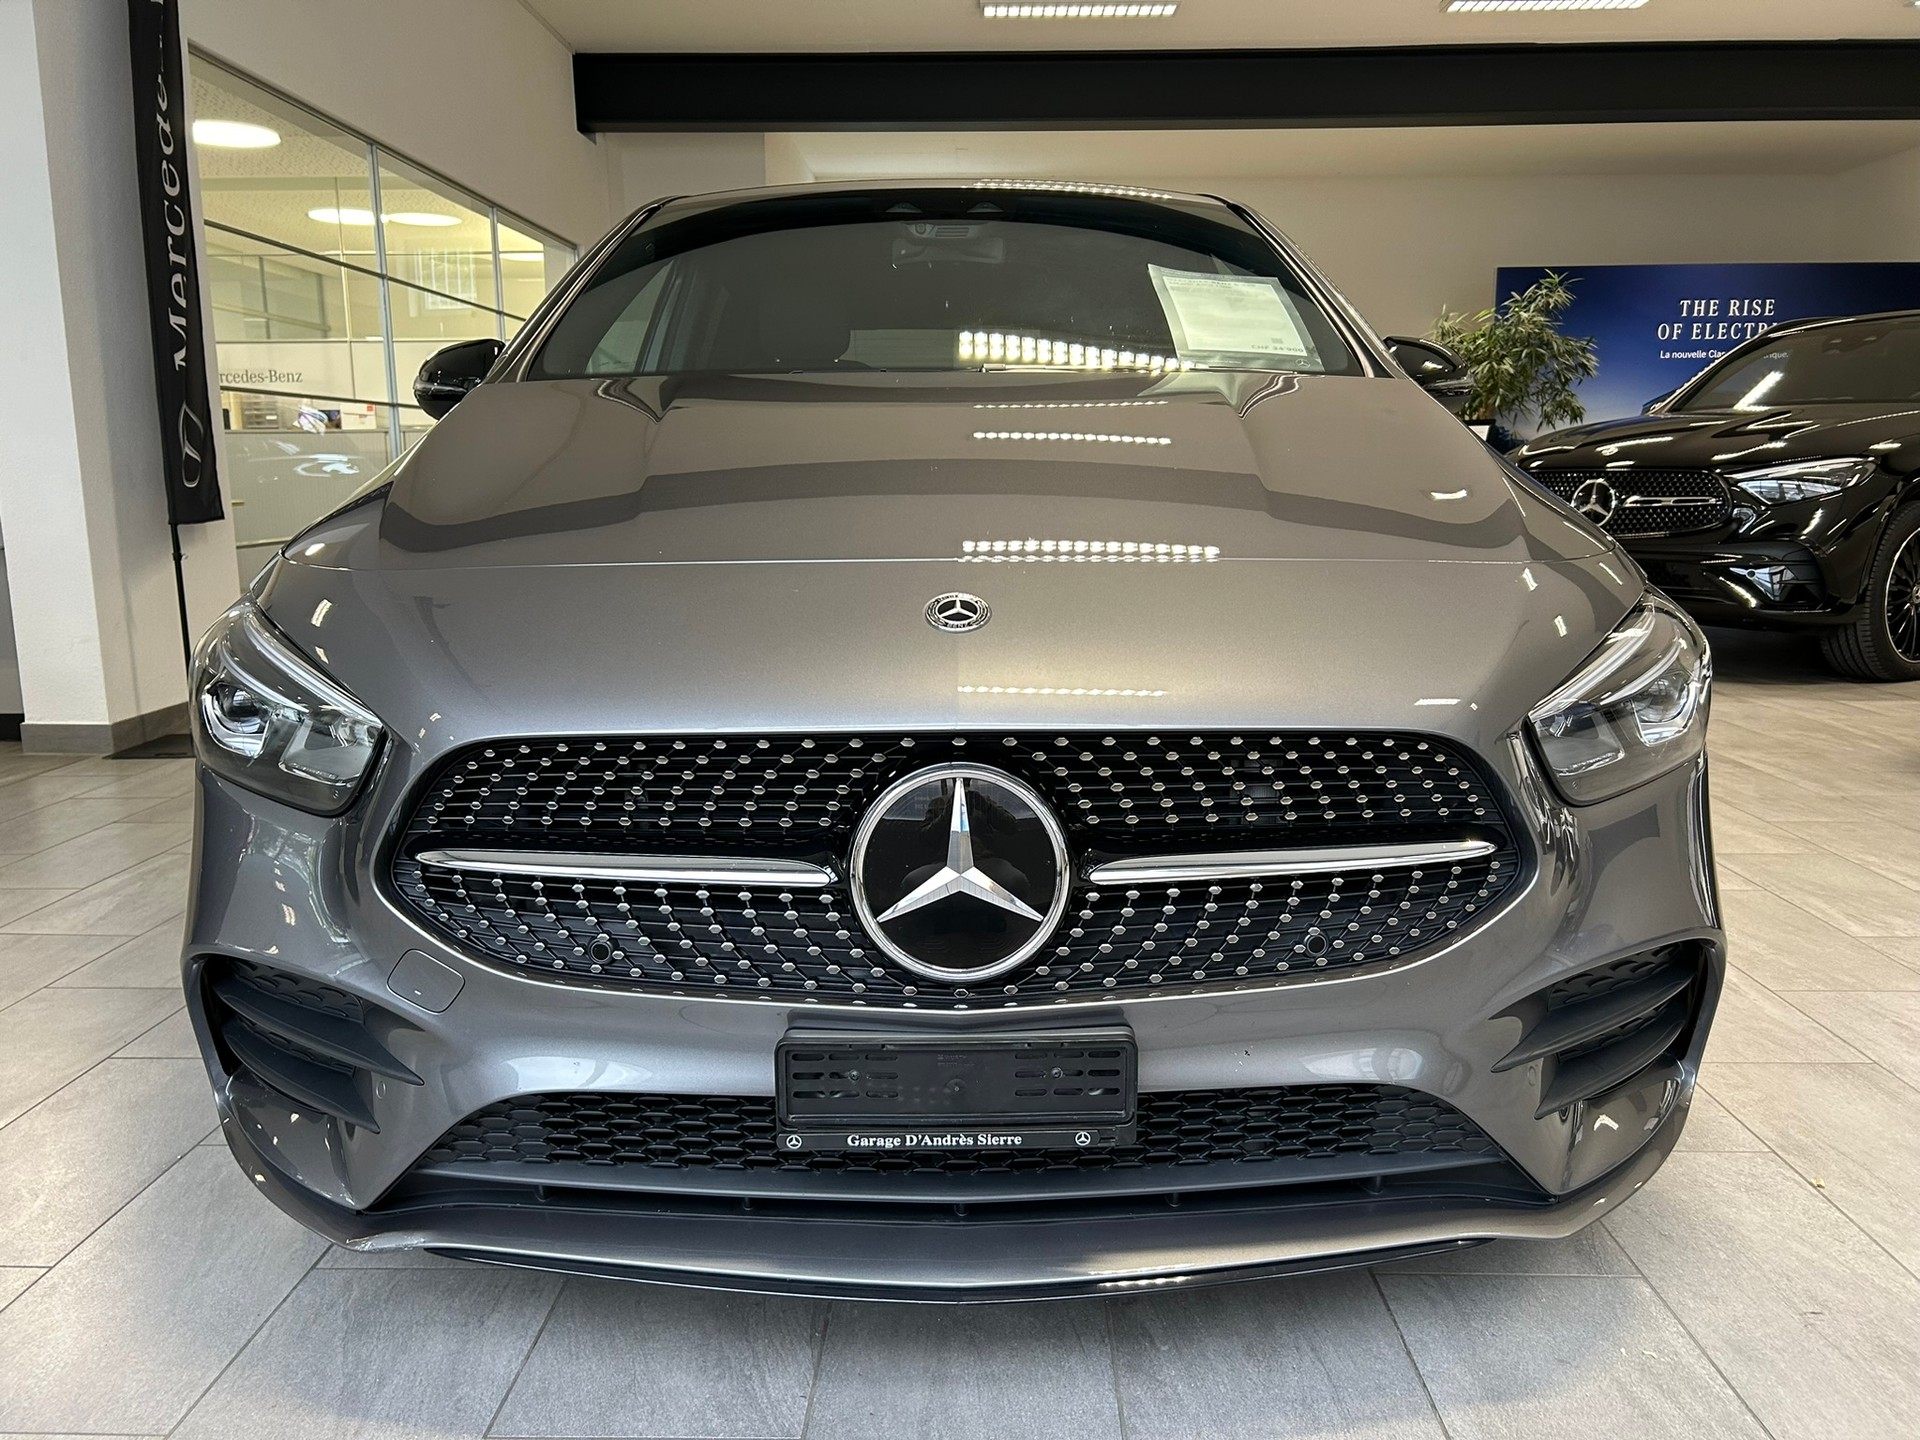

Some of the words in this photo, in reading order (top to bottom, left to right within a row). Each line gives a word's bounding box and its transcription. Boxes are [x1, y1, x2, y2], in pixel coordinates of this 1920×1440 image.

[156, 34, 187, 371] Mercede
[1679, 299, 1720, 317] THE
[1728, 299, 1776, 317] RISE
[1657, 323, 1683, 340] OF
[1691, 322, 1778, 340] ELECTR
[1660, 350, 1670, 359] La
[1672, 350, 1706, 359] nouvelle
[220, 369, 304, 384] rcedes-Benz
[847, 1134, 902, 1148] Garage
[905, 1133, 974, 1146] D'Andrès
[977, 1133, 1023, 1146] Sierre
